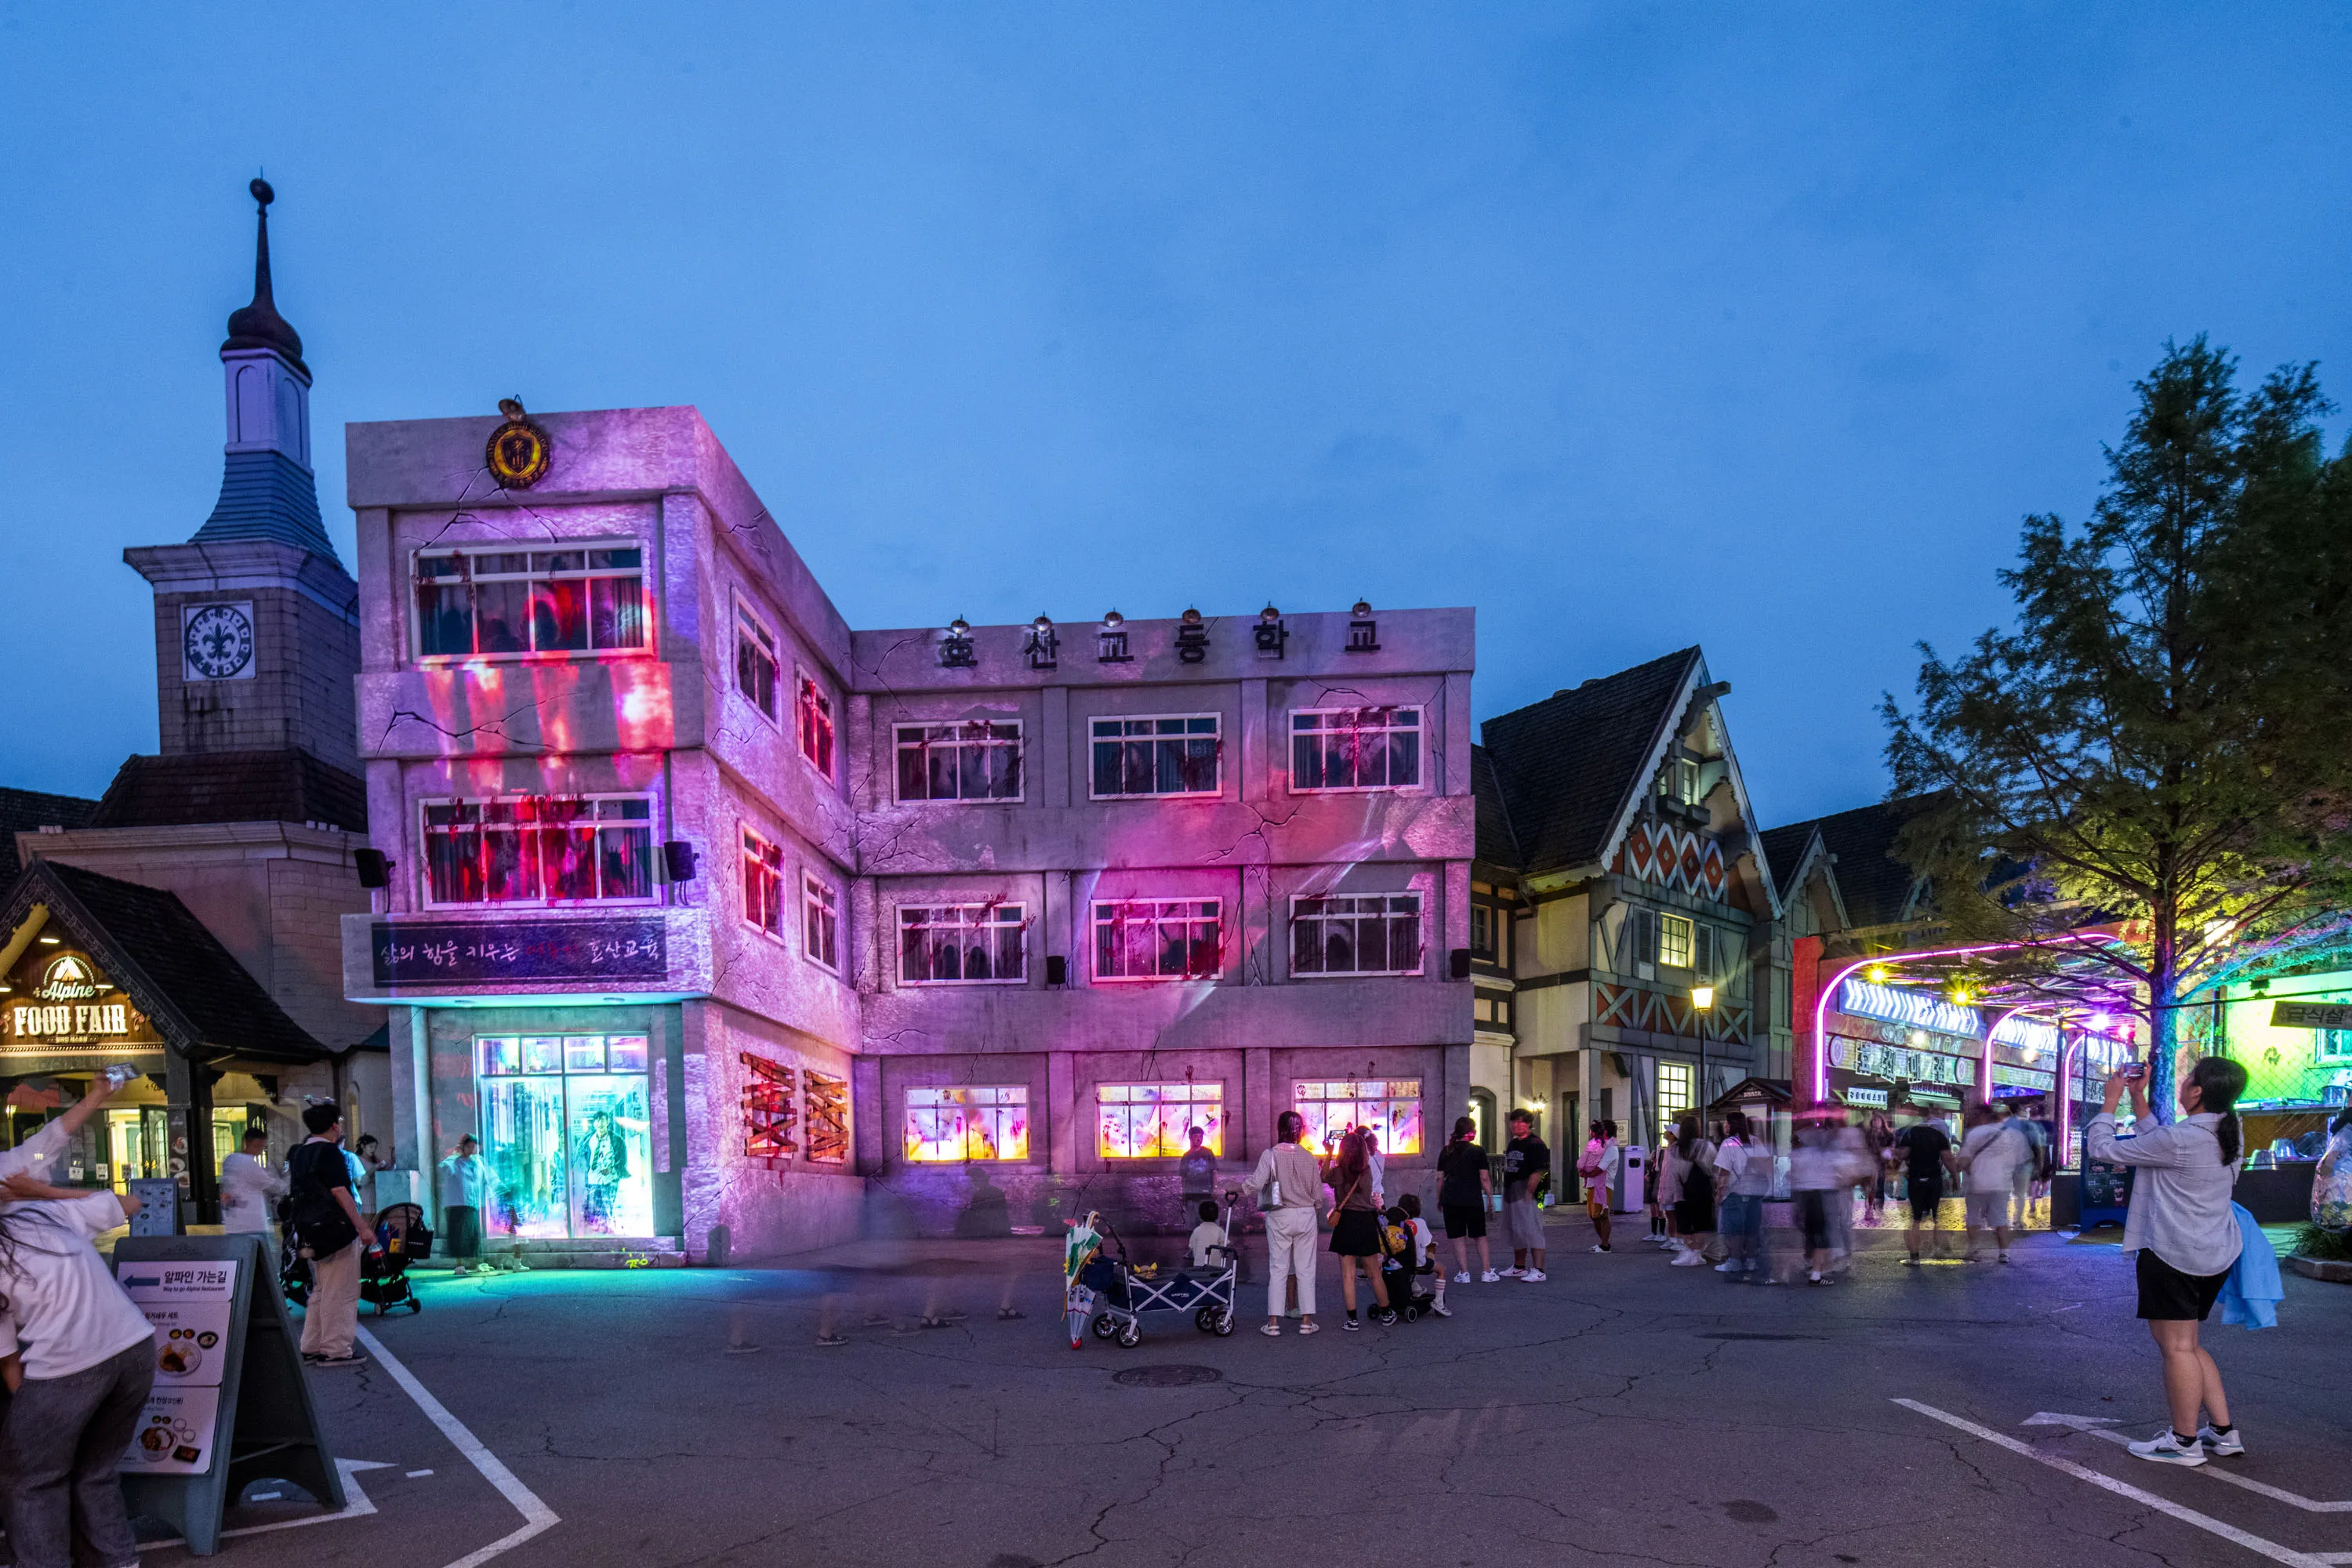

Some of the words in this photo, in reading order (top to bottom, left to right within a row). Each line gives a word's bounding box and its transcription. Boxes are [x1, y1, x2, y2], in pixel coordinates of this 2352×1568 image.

[380, 942, 415, 966] 삶의
[423, 940, 459, 967] 힘을
[466, 942, 521, 962] 키우는
[589, 938, 659, 964] 효산교육
[41, 980, 96, 1002] Alpine
[14, 1005, 71, 1036] FOOD
[75, 1004, 129, 1034] FAIR
[165, 1270, 194, 1283] 알파인
[197, 1270, 227, 1283] 가는길
